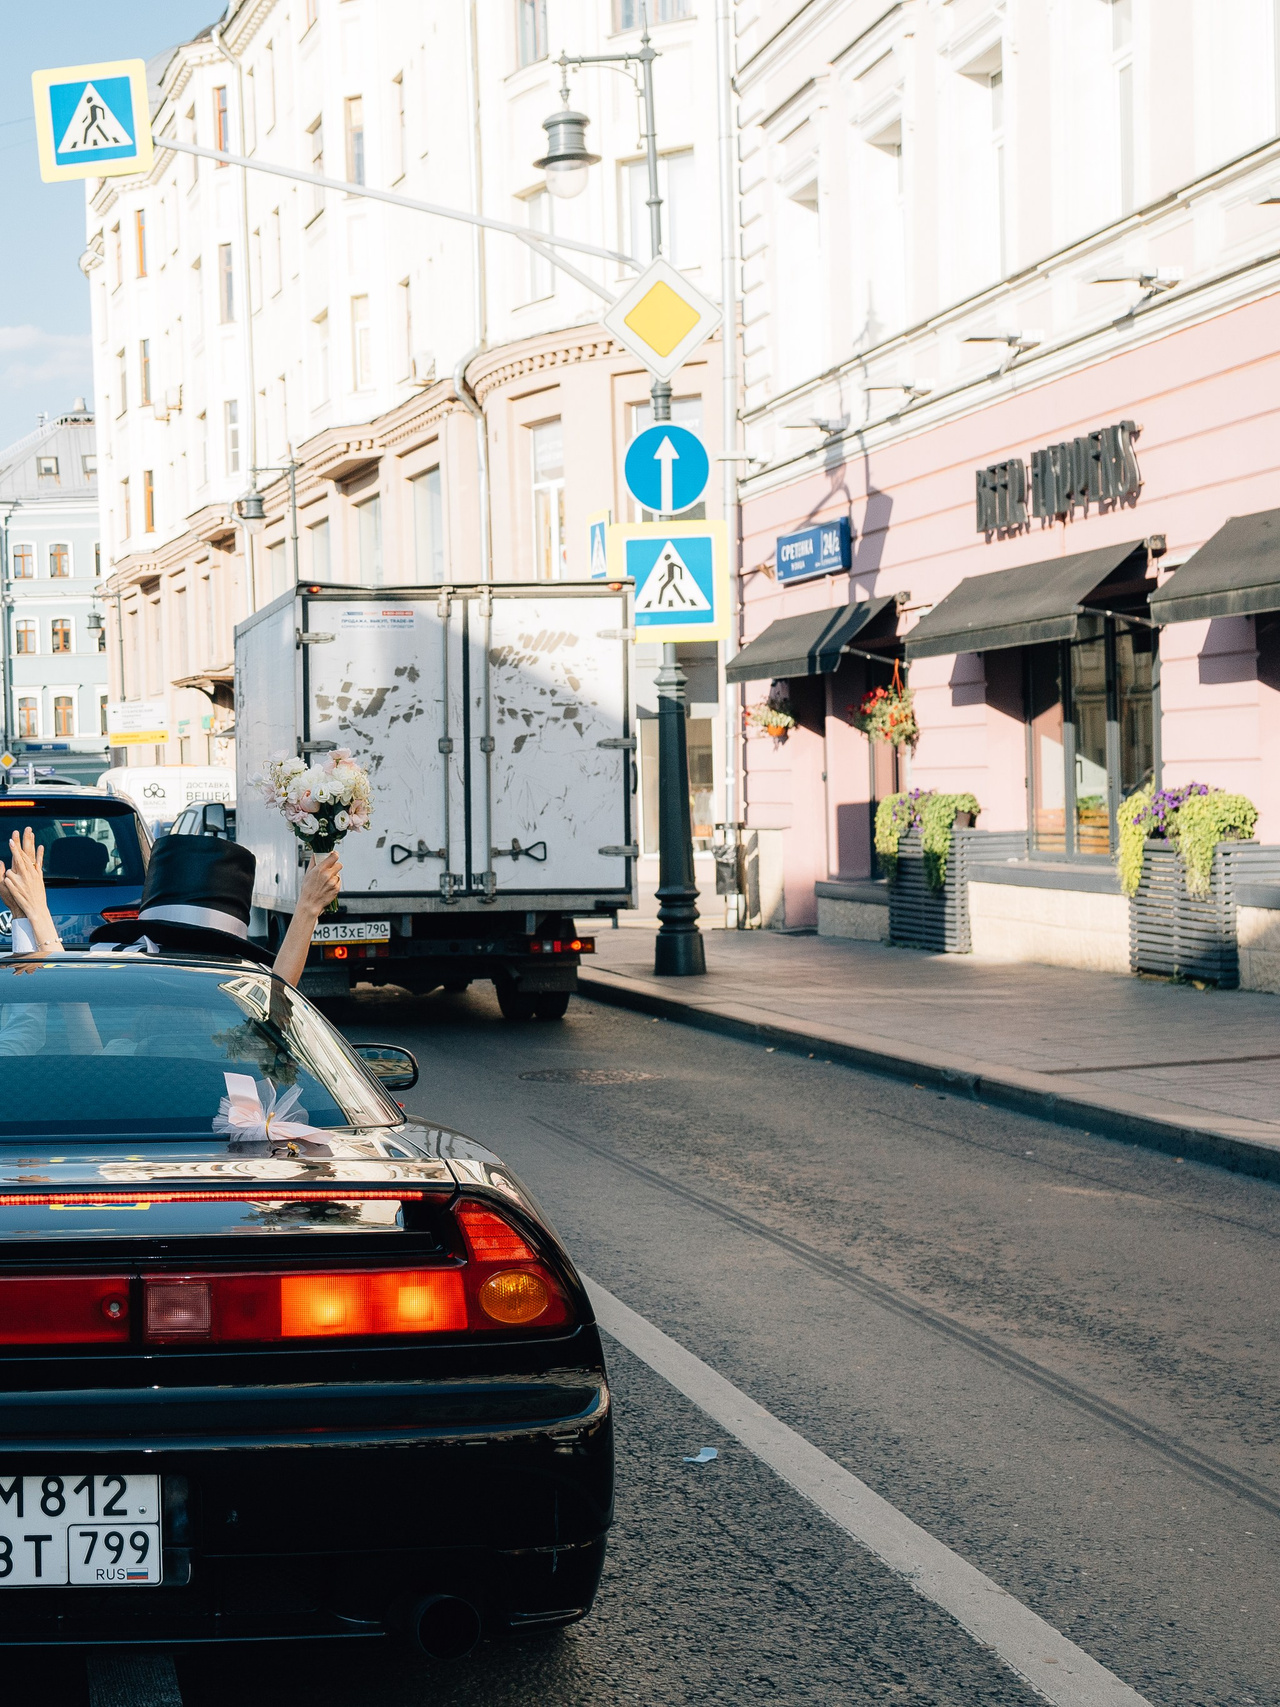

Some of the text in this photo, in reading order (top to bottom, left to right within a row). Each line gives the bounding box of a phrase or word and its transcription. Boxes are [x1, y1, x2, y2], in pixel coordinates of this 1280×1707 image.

[781, 538, 814, 562] СРЕТЕНКА
[79, 1531, 150, 1565] 799
[96, 1568, 126, 1581] RUS
